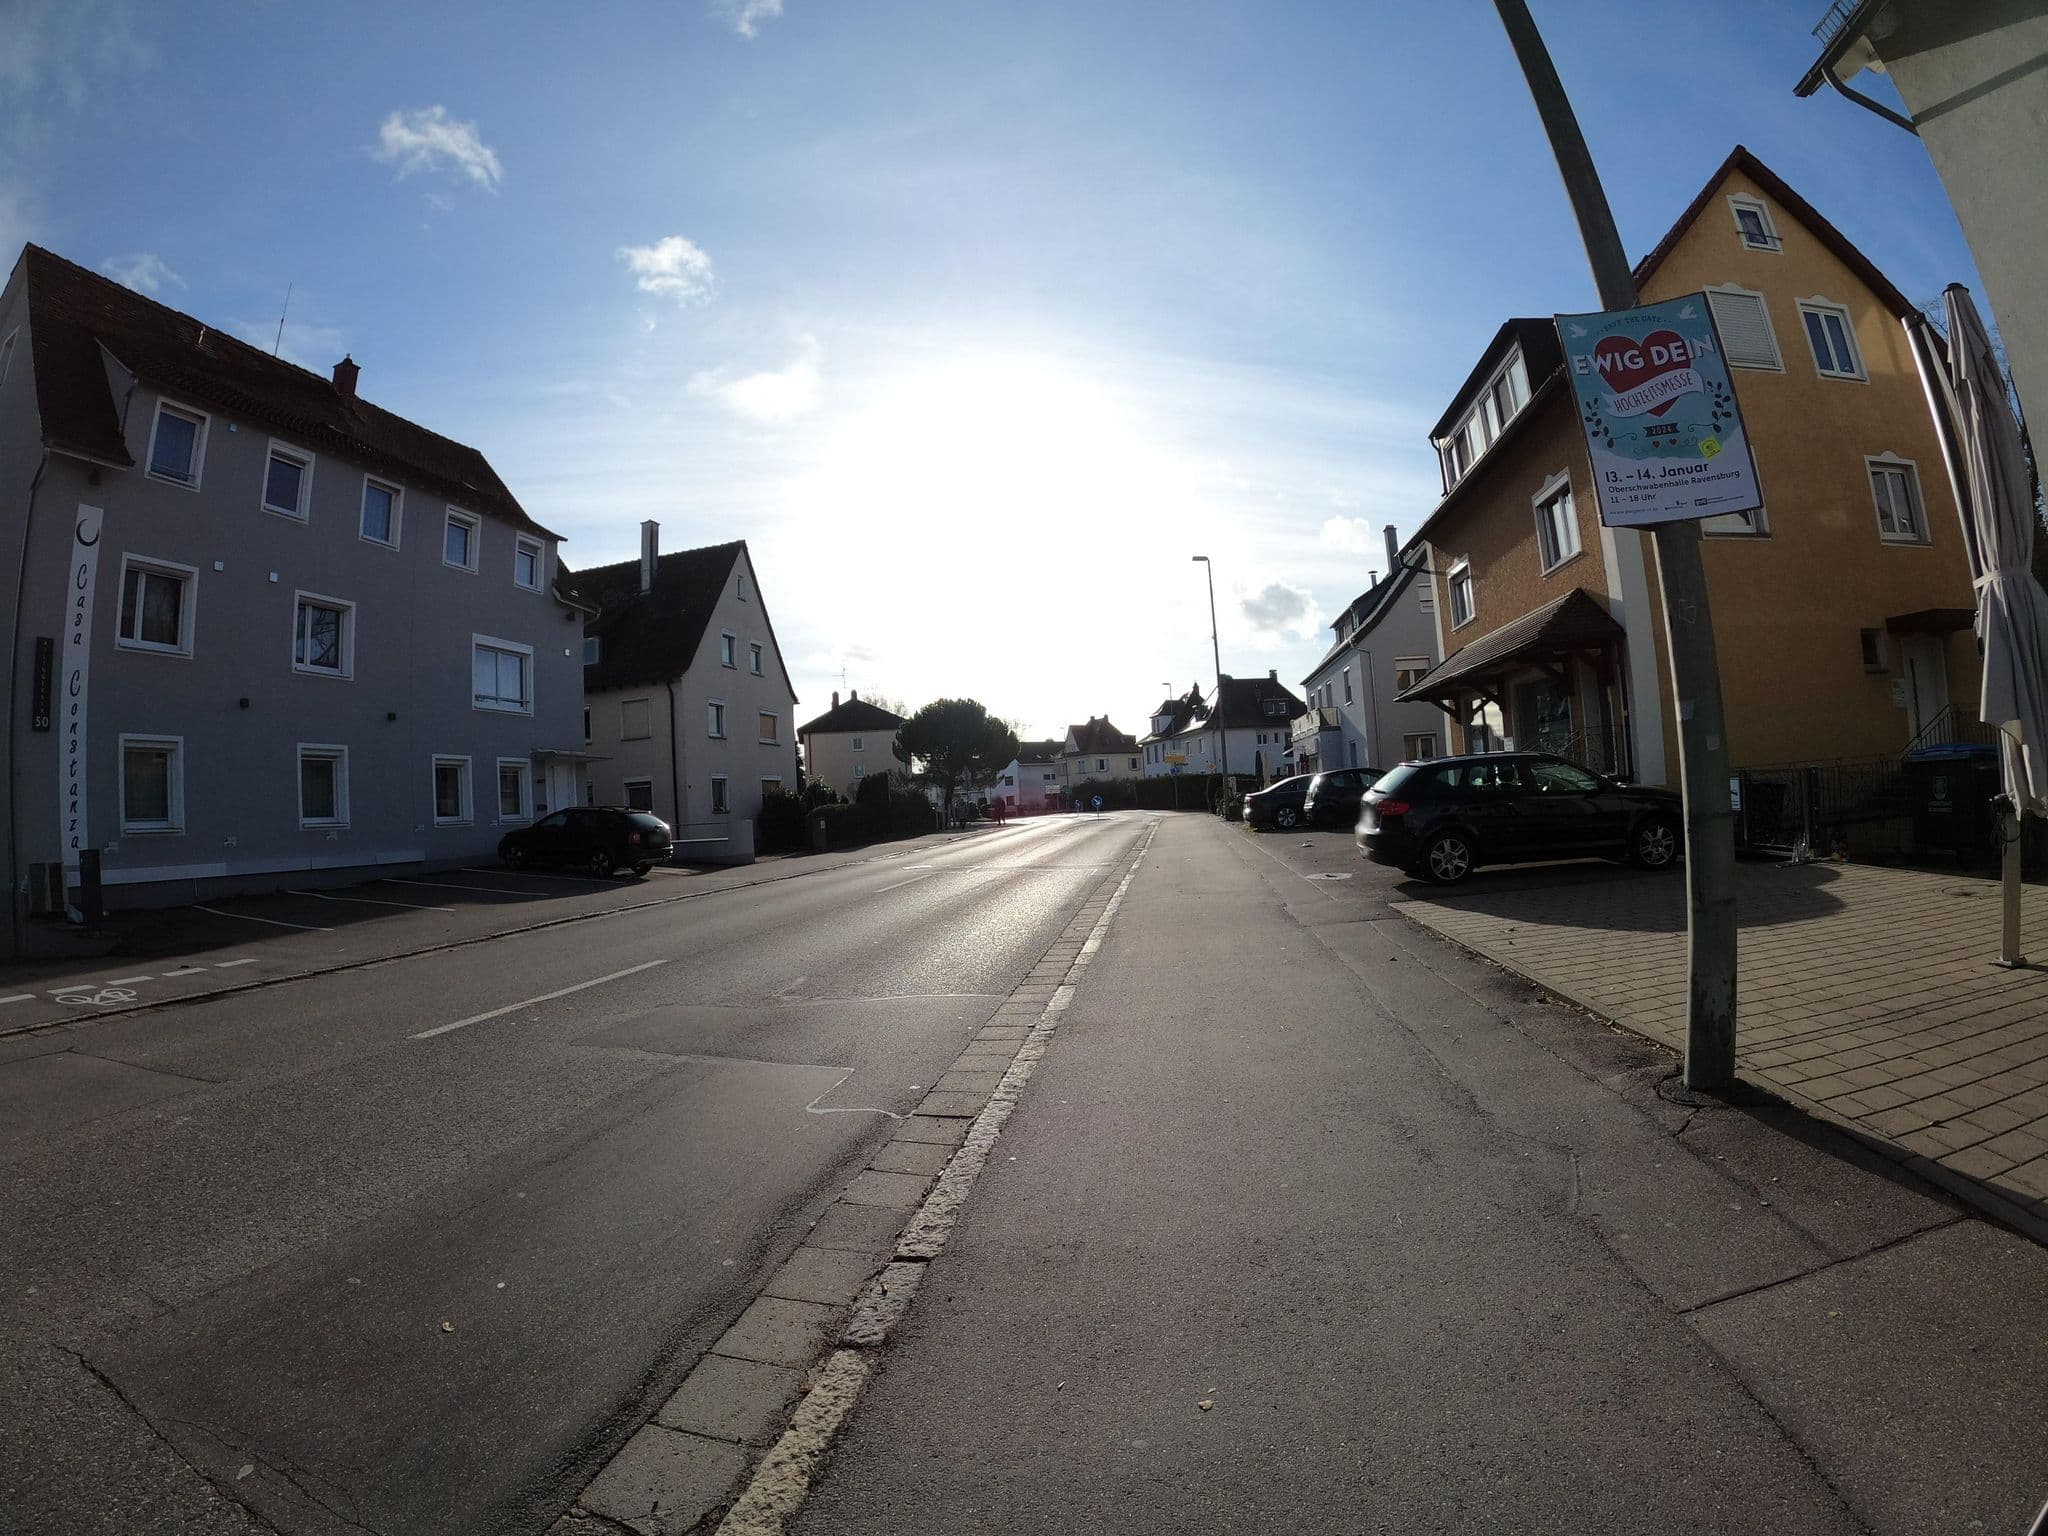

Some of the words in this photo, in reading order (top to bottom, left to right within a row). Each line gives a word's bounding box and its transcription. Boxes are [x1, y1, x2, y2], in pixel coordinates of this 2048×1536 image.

[1573, 349, 1646, 375] EWIG
[1650, 334, 1717, 366] DEIN
[1613, 372, 1694, 413] HOCHZEITSMESSE
[1651, 424, 1673, 435] 2024
[1605, 470, 1622, 483] 13.
[1637, 468, 1655, 481] 14.
[1659, 463, 1709, 478] Januar
[1608, 479, 1689, 493] Oberschwabenhalle
[1691, 469, 1740, 485] Ravensburg
[1610, 496, 1619, 504] 11
[1629, 494, 1639, 503] 18
[1641, 492, 1656, 502] Uhr
[73, 563, 87, 646] Casa
[34, 715, 49, 727] 50
[69, 669, 80, 850] Constanza
